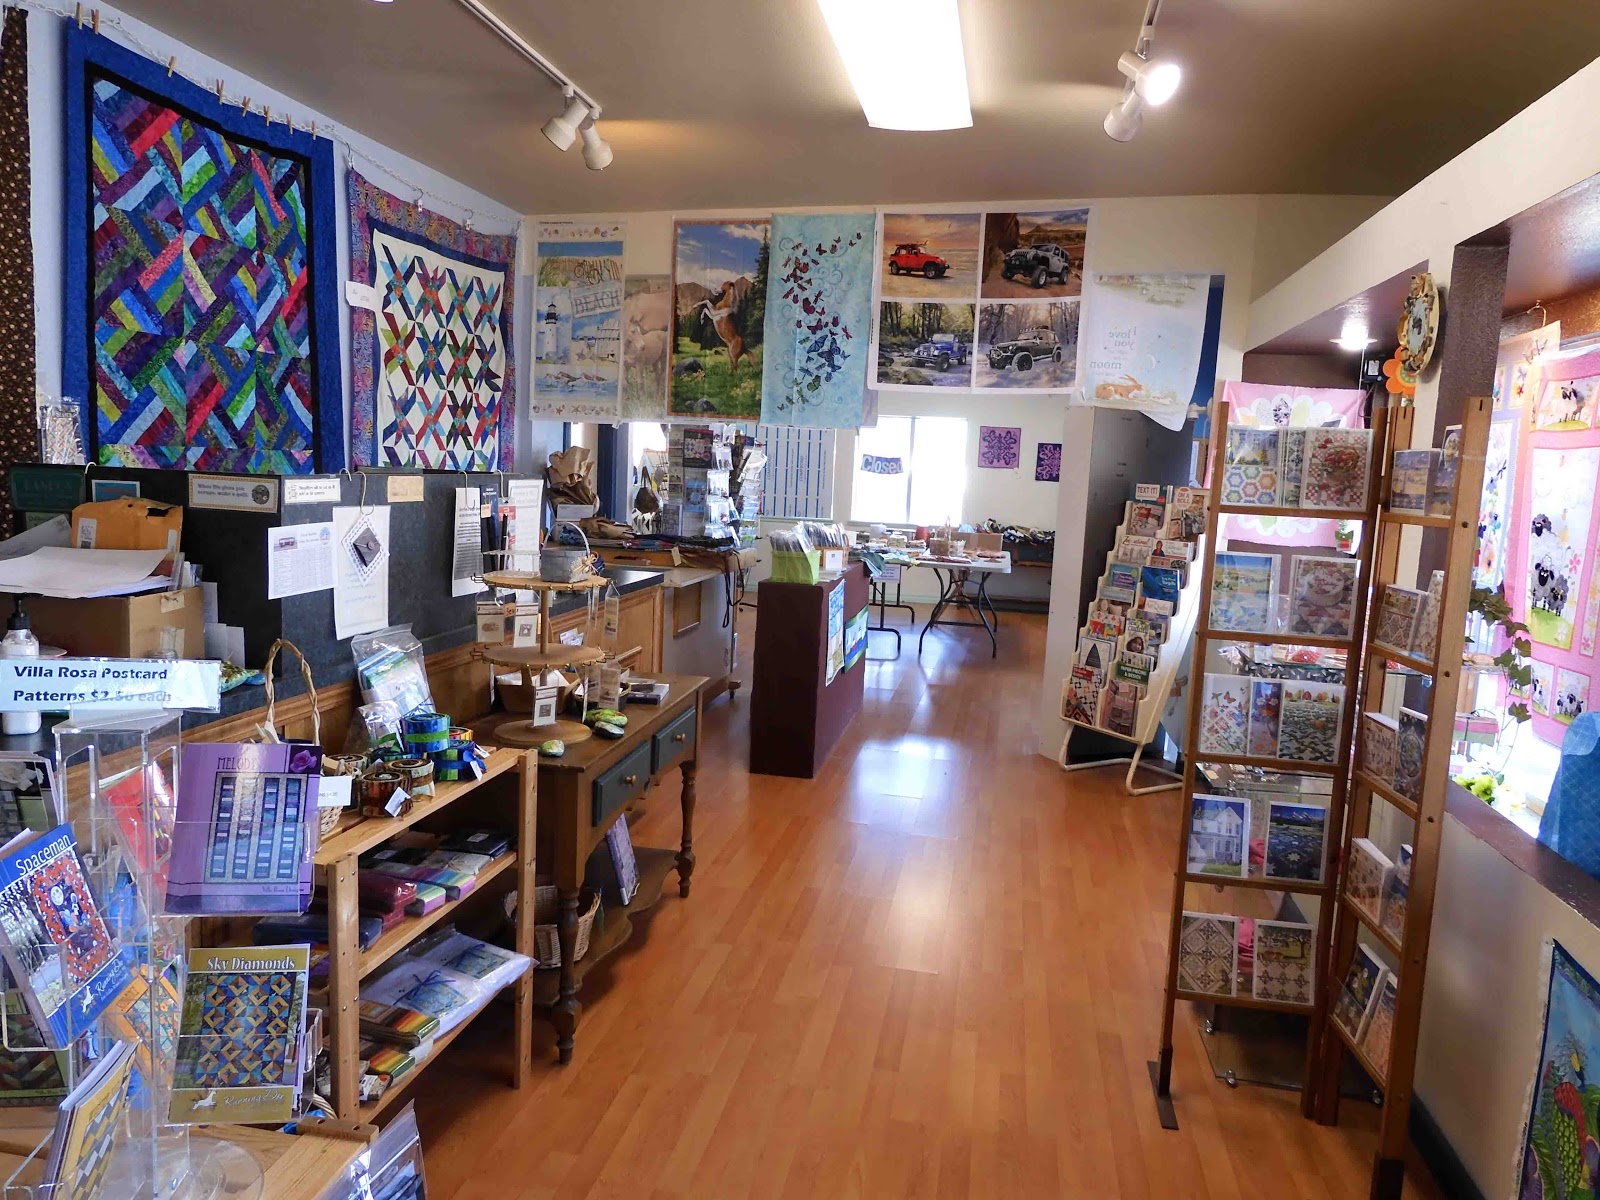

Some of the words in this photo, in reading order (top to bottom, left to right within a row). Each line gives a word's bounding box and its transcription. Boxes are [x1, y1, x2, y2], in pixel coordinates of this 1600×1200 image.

[574, 290, 620, 314] BEACH
[861, 454, 903, 475] Closed
[1137, 486, 1150, 494] TEXT
[13, 665, 53, 678] Villa
[58, 666, 97, 678] Rosa
[101, 667, 168, 680] Postcard
[13, 690, 85, 702] Patterns
[135, 691, 171, 702] each
[15, 833, 72, 876] Spaceman
[207, 956, 229, 971] Sky
[231, 956, 296, 970] Diamonds
